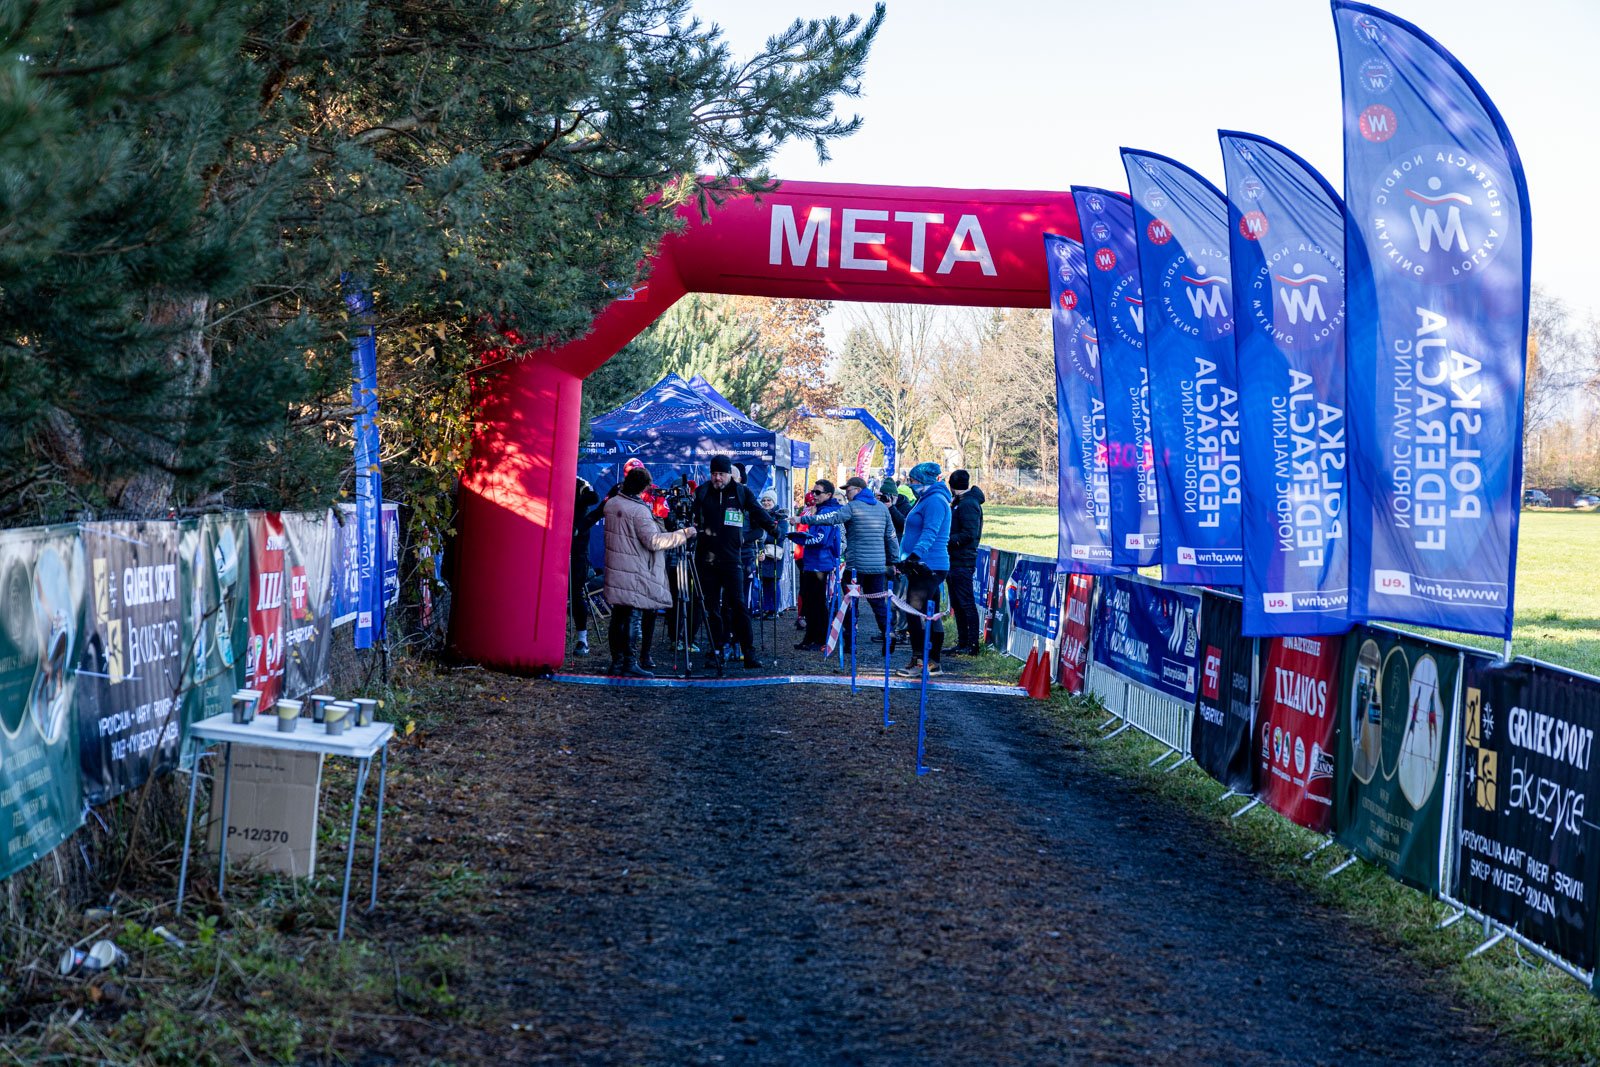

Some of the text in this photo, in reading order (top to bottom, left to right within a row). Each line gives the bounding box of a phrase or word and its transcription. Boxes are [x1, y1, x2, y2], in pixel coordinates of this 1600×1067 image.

[769, 204, 997, 276] META
[1553, 719, 1594, 771] SPORT
[227, 826, 288, 844] P-12/370
